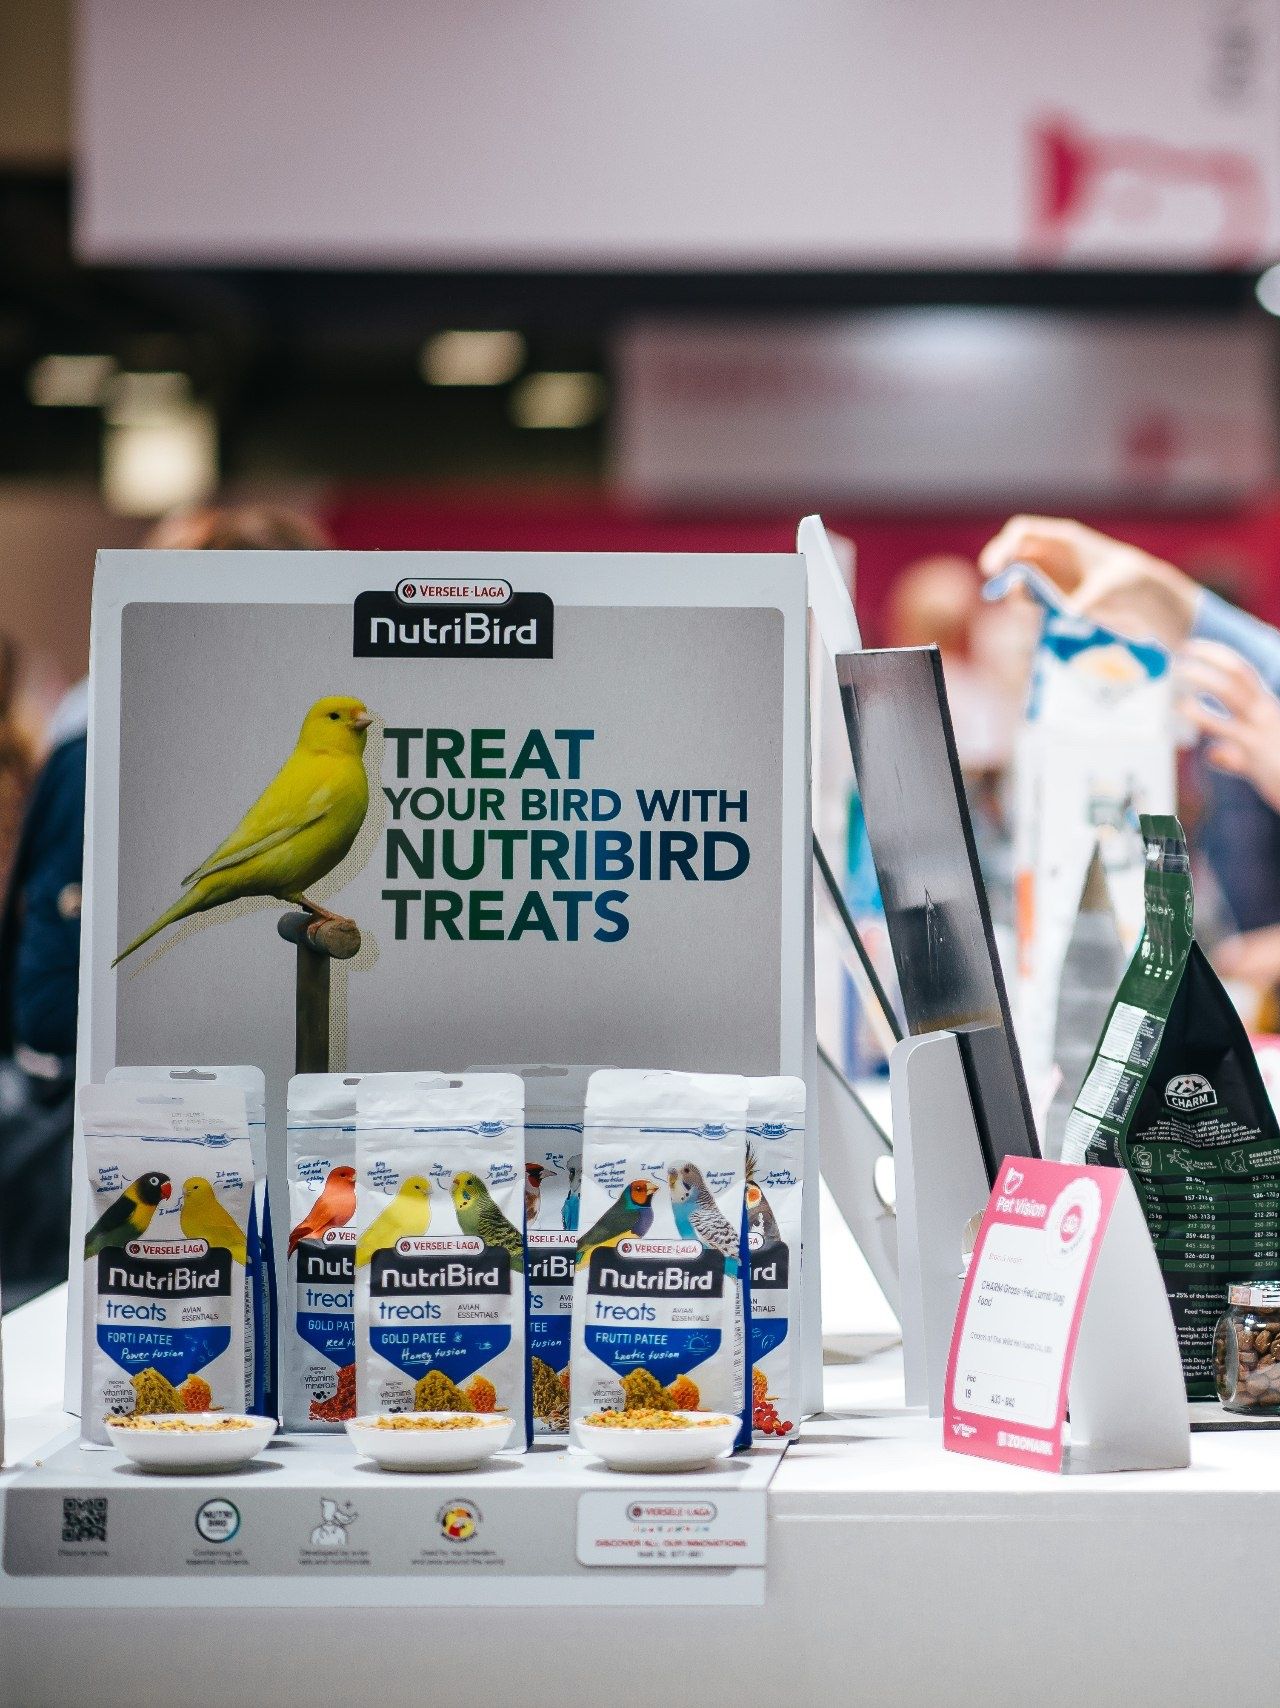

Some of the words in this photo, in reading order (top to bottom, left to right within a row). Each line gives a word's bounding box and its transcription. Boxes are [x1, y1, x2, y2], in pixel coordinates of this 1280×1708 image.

[383, 727, 595, 780] TREAT
[381, 786, 506, 822] YOUR
[521, 788, 622, 822] BIRD
[635, 788, 748, 823] WITH
[386, 827, 751, 882] NUTRIBIRD
[381, 888, 631, 943] TREATS
[1172, 1093, 1208, 1108] CHARM
[996, 1195, 1014, 1212] Pet
[1016, 1198, 1048, 1218] Vision
[306, 1288, 354, 1307] treat
[981, 1280, 1003, 1292] CHARM
[1036, 1290, 1052, 1301] Lamb
[1053, 1292, 1066, 1306] Dog
[978, 1296, 993, 1306] Food
[106, 1300, 167, 1321] treats
[182, 1306, 202, 1314] AVIAN
[379, 1301, 442, 1320] treats
[596, 1300, 656, 1320] treats
[182, 1313, 219, 1322] ESSENTIALS
[308, 1320, 334, 1330] GOLD
[336, 1321, 354, 1331] PAT
[108, 1332, 136, 1343] FORTI
[138, 1334, 172, 1346] PATEE
[326, 1338, 344, 1347] Red
[382, 1334, 408, 1344] GOLD
[412, 1333, 446, 1344] PATEE
[531, 1340, 562, 1348] fusion
[596, 1333, 631, 1344] FRUTTI
[634, 1334, 668, 1344] PATEE
[120, 1348, 149, 1360] Power
[152, 1350, 184, 1358] fusion
[402, 1350, 432, 1364] Honey
[434, 1348, 466, 1357] fusion
[614, 1350, 645, 1360] Exotic
[648, 1350, 680, 1359] fusion
[304, 1374, 334, 1382] vitamins
[306, 1382, 336, 1390] minerals
[104, 1396, 134, 1404] minerals
[380, 1390, 412, 1398] vitamins
[1007, 1433, 1053, 1456] ZOOMARK
